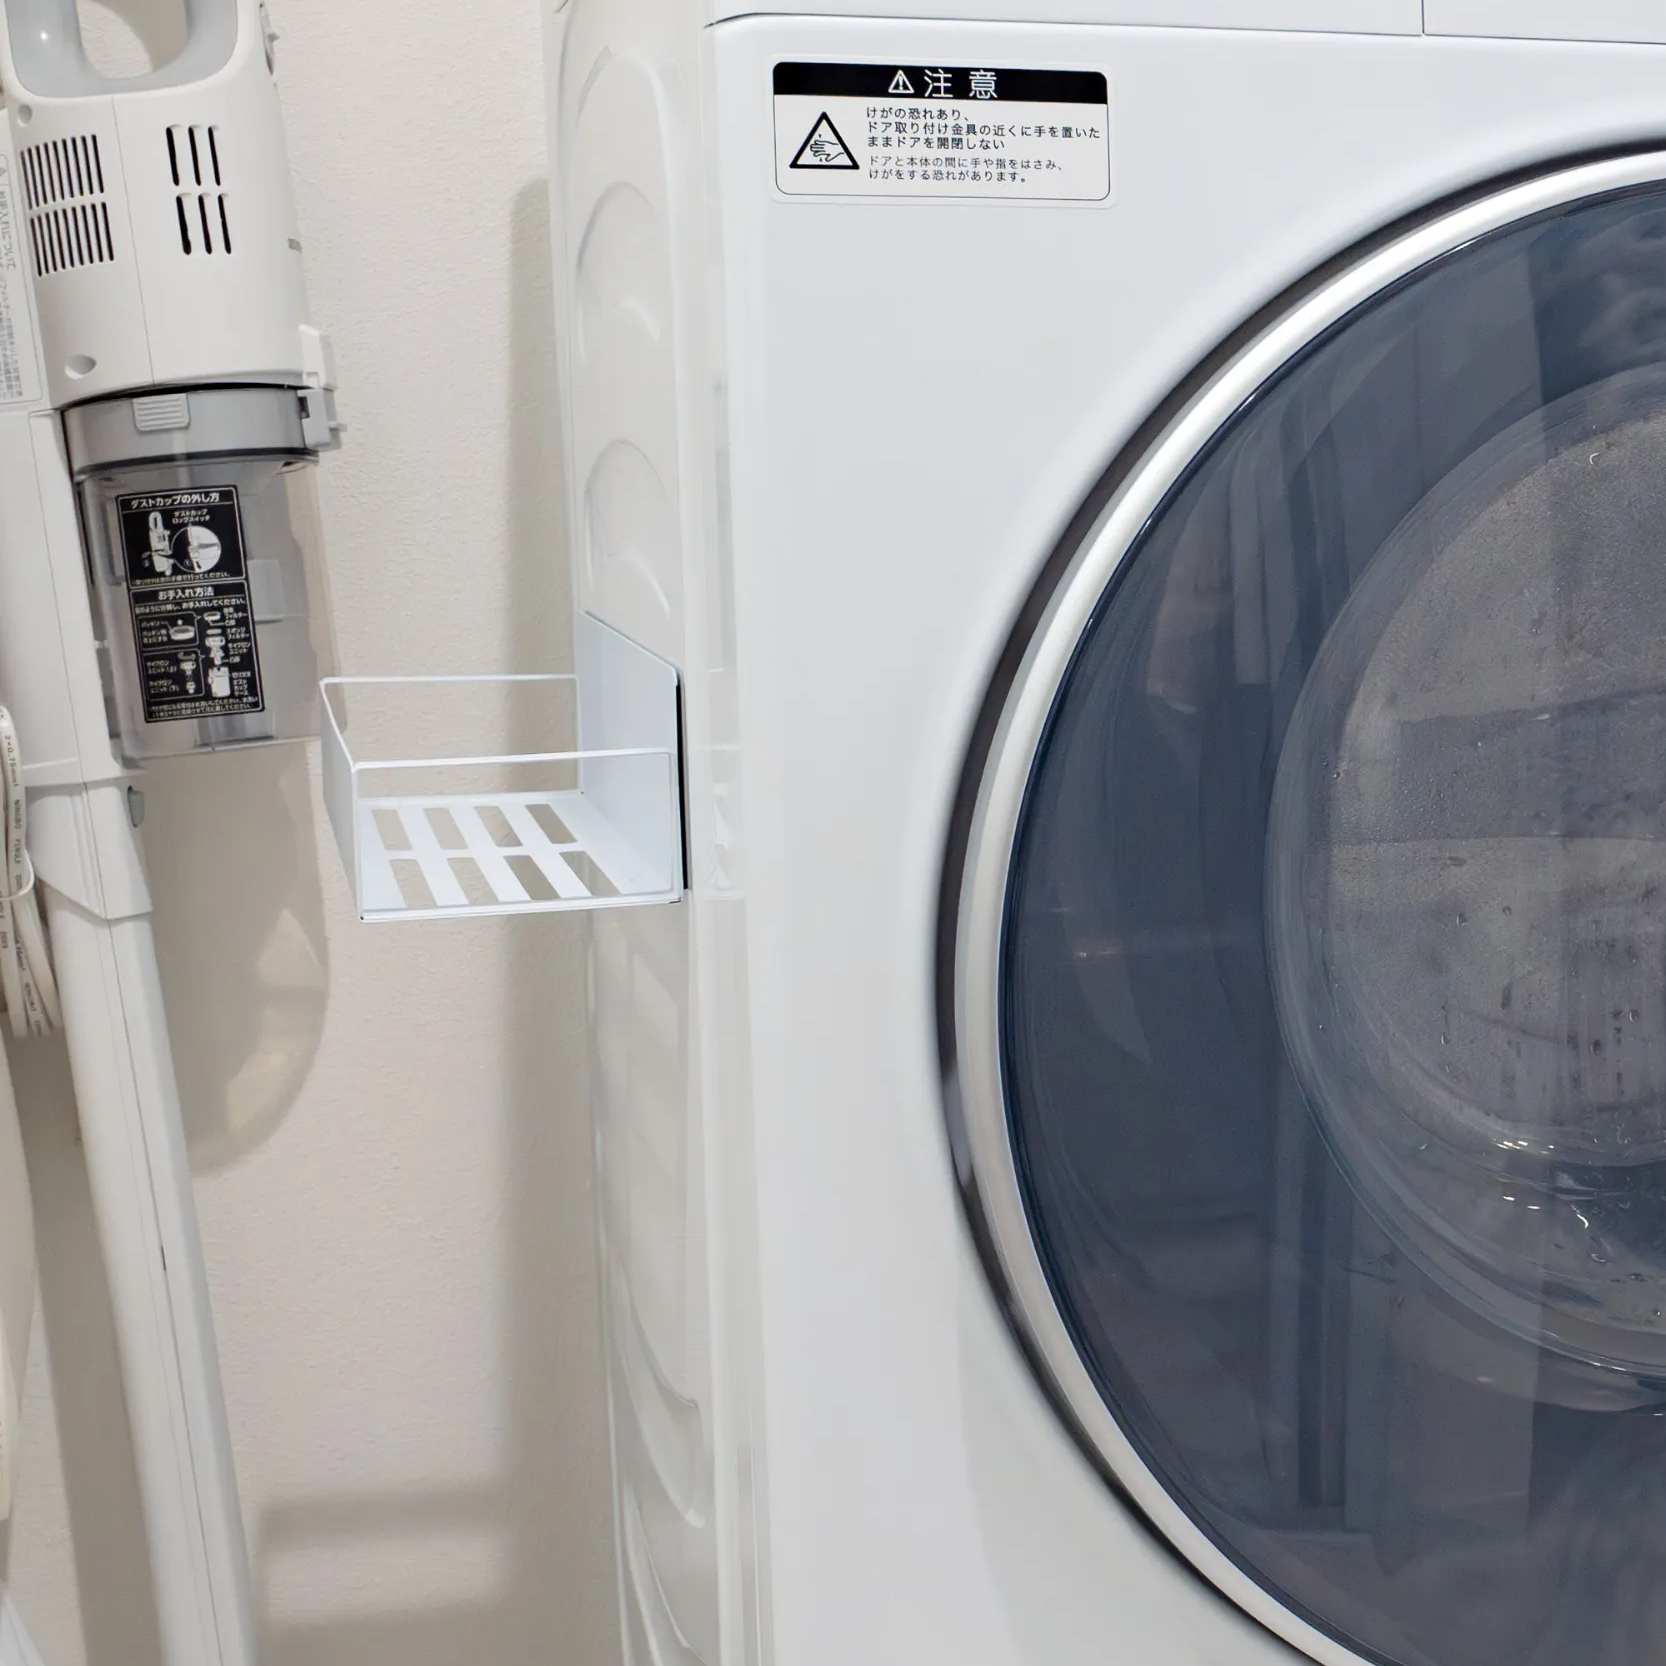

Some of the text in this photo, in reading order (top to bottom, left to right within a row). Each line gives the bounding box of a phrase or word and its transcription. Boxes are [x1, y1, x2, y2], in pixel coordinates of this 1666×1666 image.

[923, 69, 998, 99] 注意
[866, 106, 969, 122] けがの恐れあり、
[867, 121, 1101, 139] ドア取り付け金具の近くに手を置いた
[867, 136, 1006, 150] ままドアを開閉しない
[869, 155, 1063, 171] ドアと本体の間に手や指をはさみ、
[869, 169, 1027, 184] けがをする恐れがあります。
